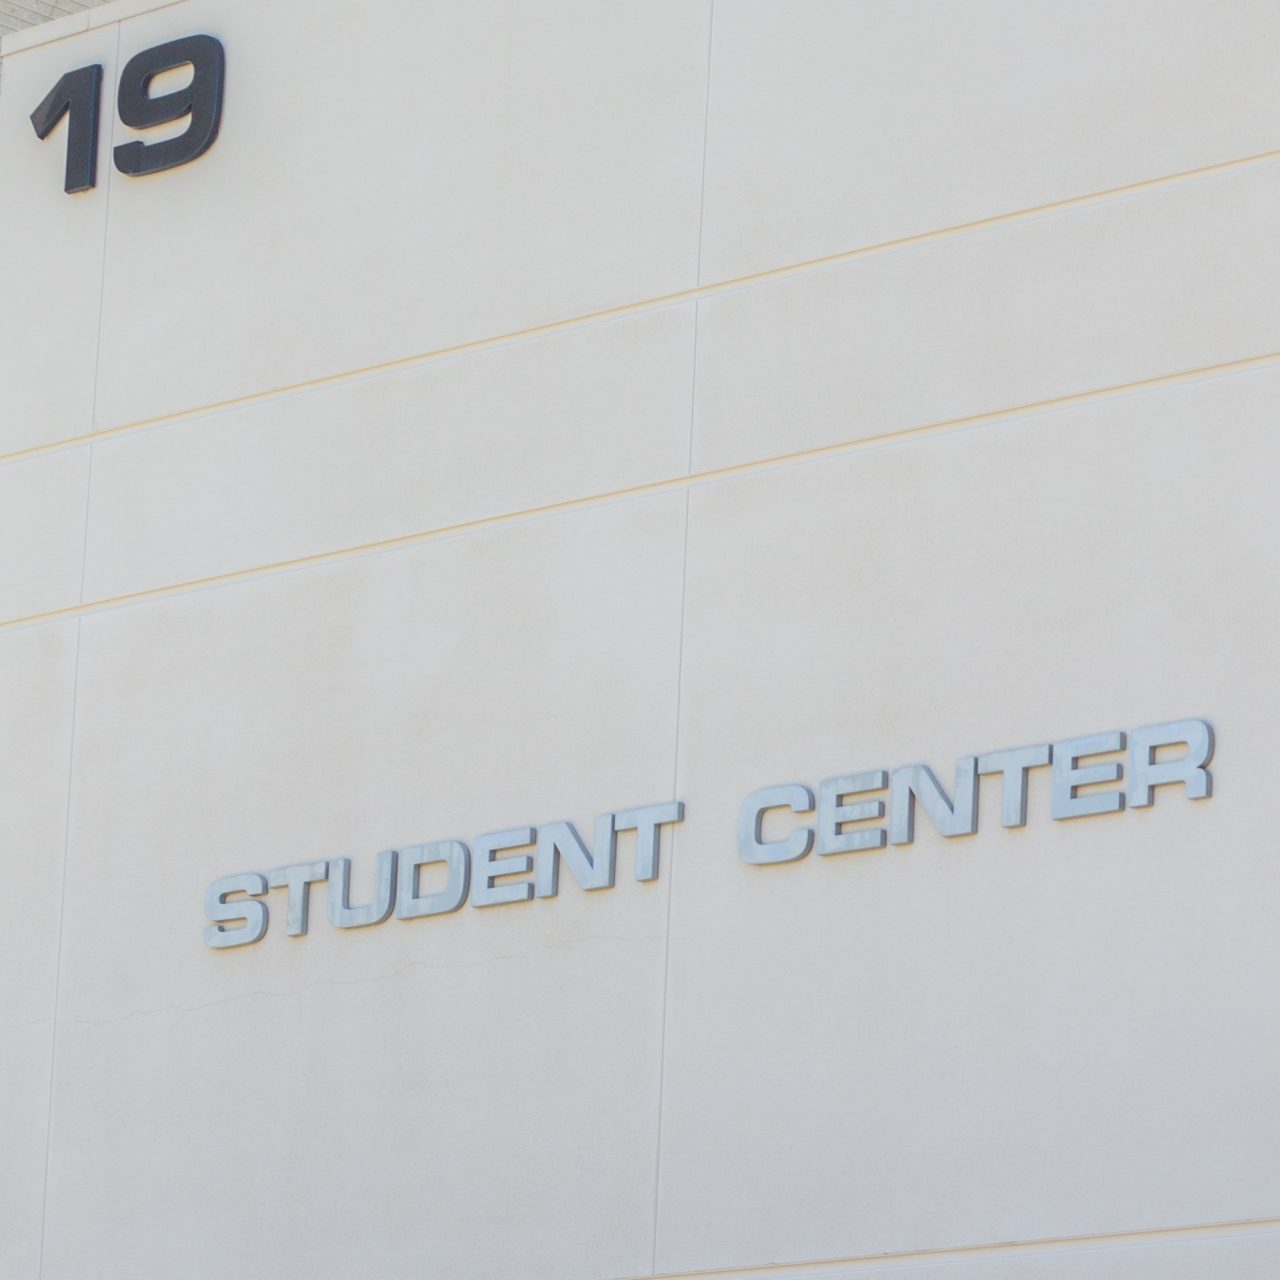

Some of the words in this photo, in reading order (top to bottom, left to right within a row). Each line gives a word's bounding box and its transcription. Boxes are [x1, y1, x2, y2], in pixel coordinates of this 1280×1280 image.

[30, 34, 225, 194] 19
[203, 801, 685, 949] STUDENT
[737, 718, 1216, 865] CENTER
